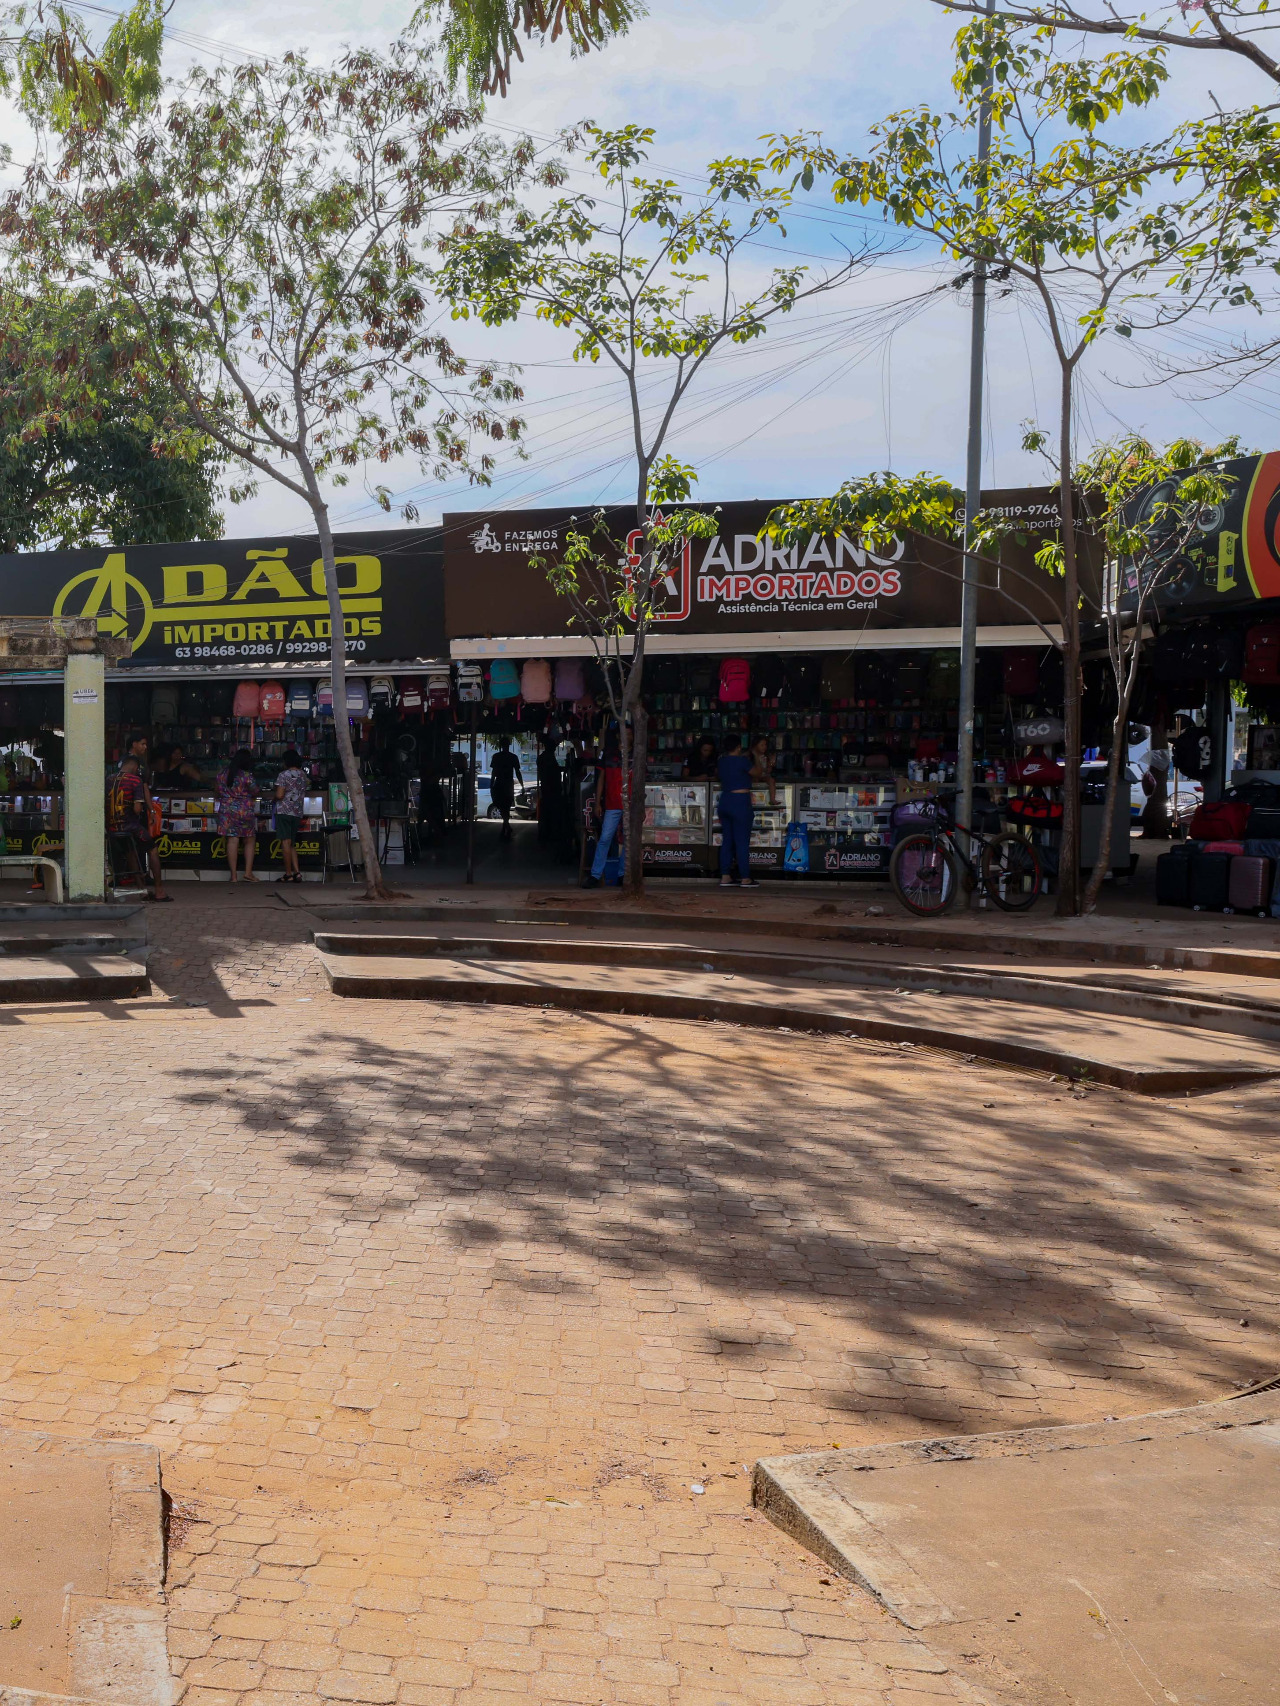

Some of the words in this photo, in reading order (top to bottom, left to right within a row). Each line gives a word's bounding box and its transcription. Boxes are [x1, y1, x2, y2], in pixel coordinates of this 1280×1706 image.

[504, 530, 558, 540] FAZEMOS
[505, 541, 558, 552] ENTREGA
[699, 529, 905, 573] ADRIANO
[696, 568, 902, 602] IMPORTADOS
[717, 602, 779, 614] Assistência
[781, 601, 824, 612] Técnica
[826, 601, 844, 610] em
[847, 599, 878, 610] Geral
[175, 647, 191, 658] 63
[194, 643, 274, 658] 98468-0286
[286, 639, 367, 655] 99298-270
[840, 853, 881, 861] ADRIANO
